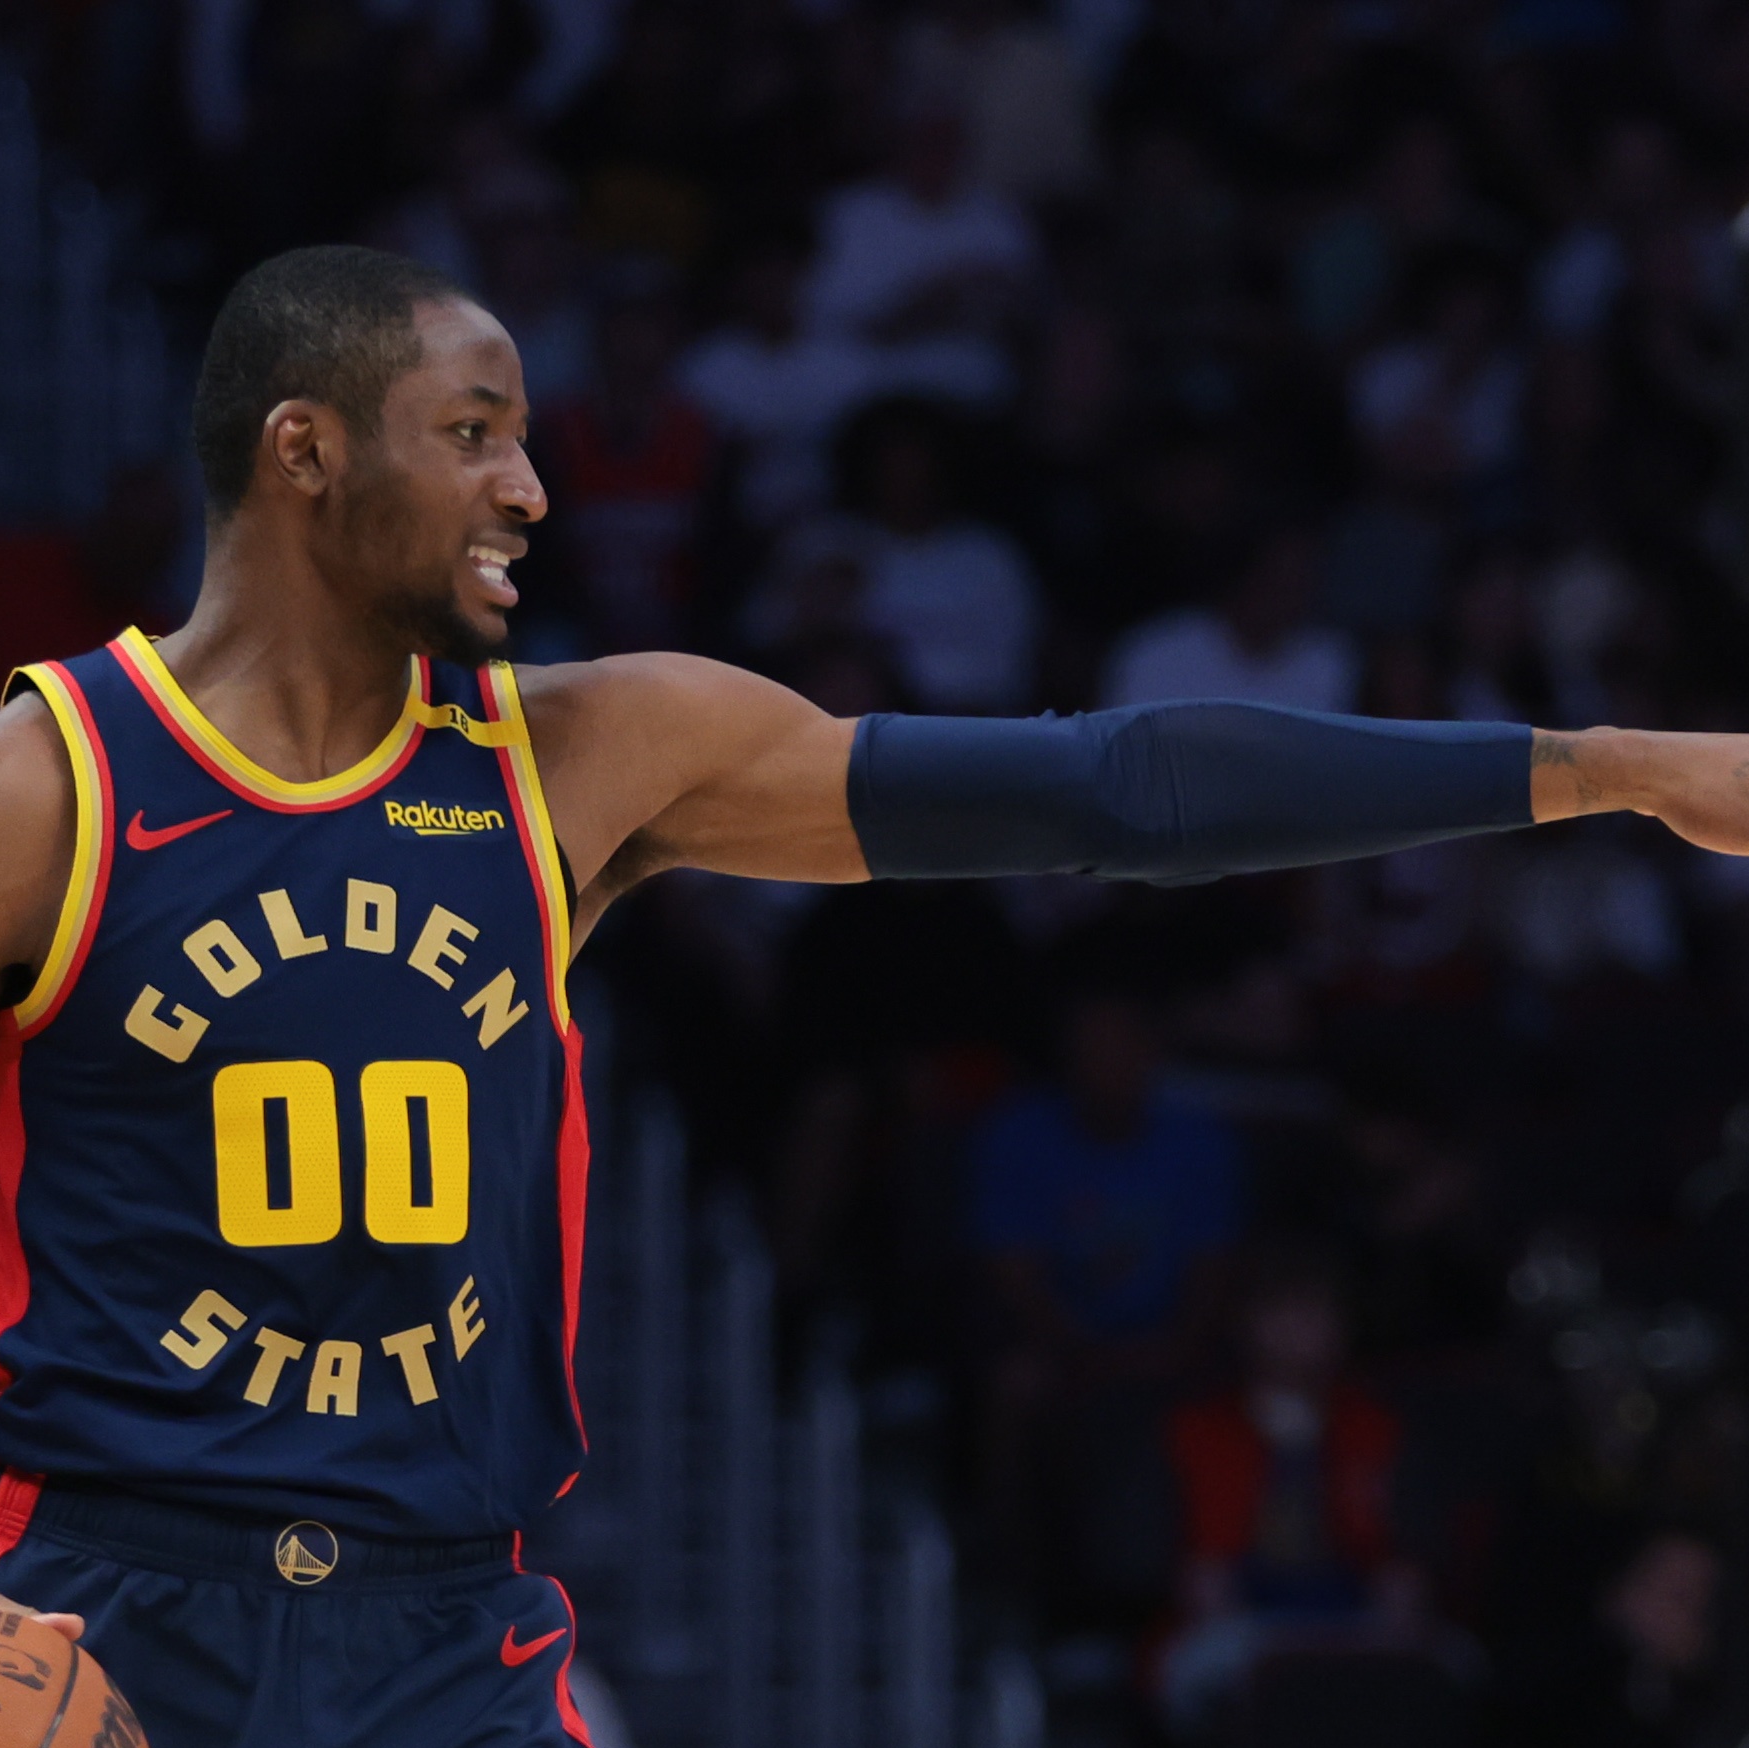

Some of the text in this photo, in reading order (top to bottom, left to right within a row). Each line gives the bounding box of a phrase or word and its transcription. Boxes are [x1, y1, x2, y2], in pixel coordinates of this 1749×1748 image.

[384, 800, 504, 831] Rakuten
[124, 878, 530, 1063] GOLDEN
[212, 1059, 470, 1247] 00
[159, 1275, 487, 1417] STATE
